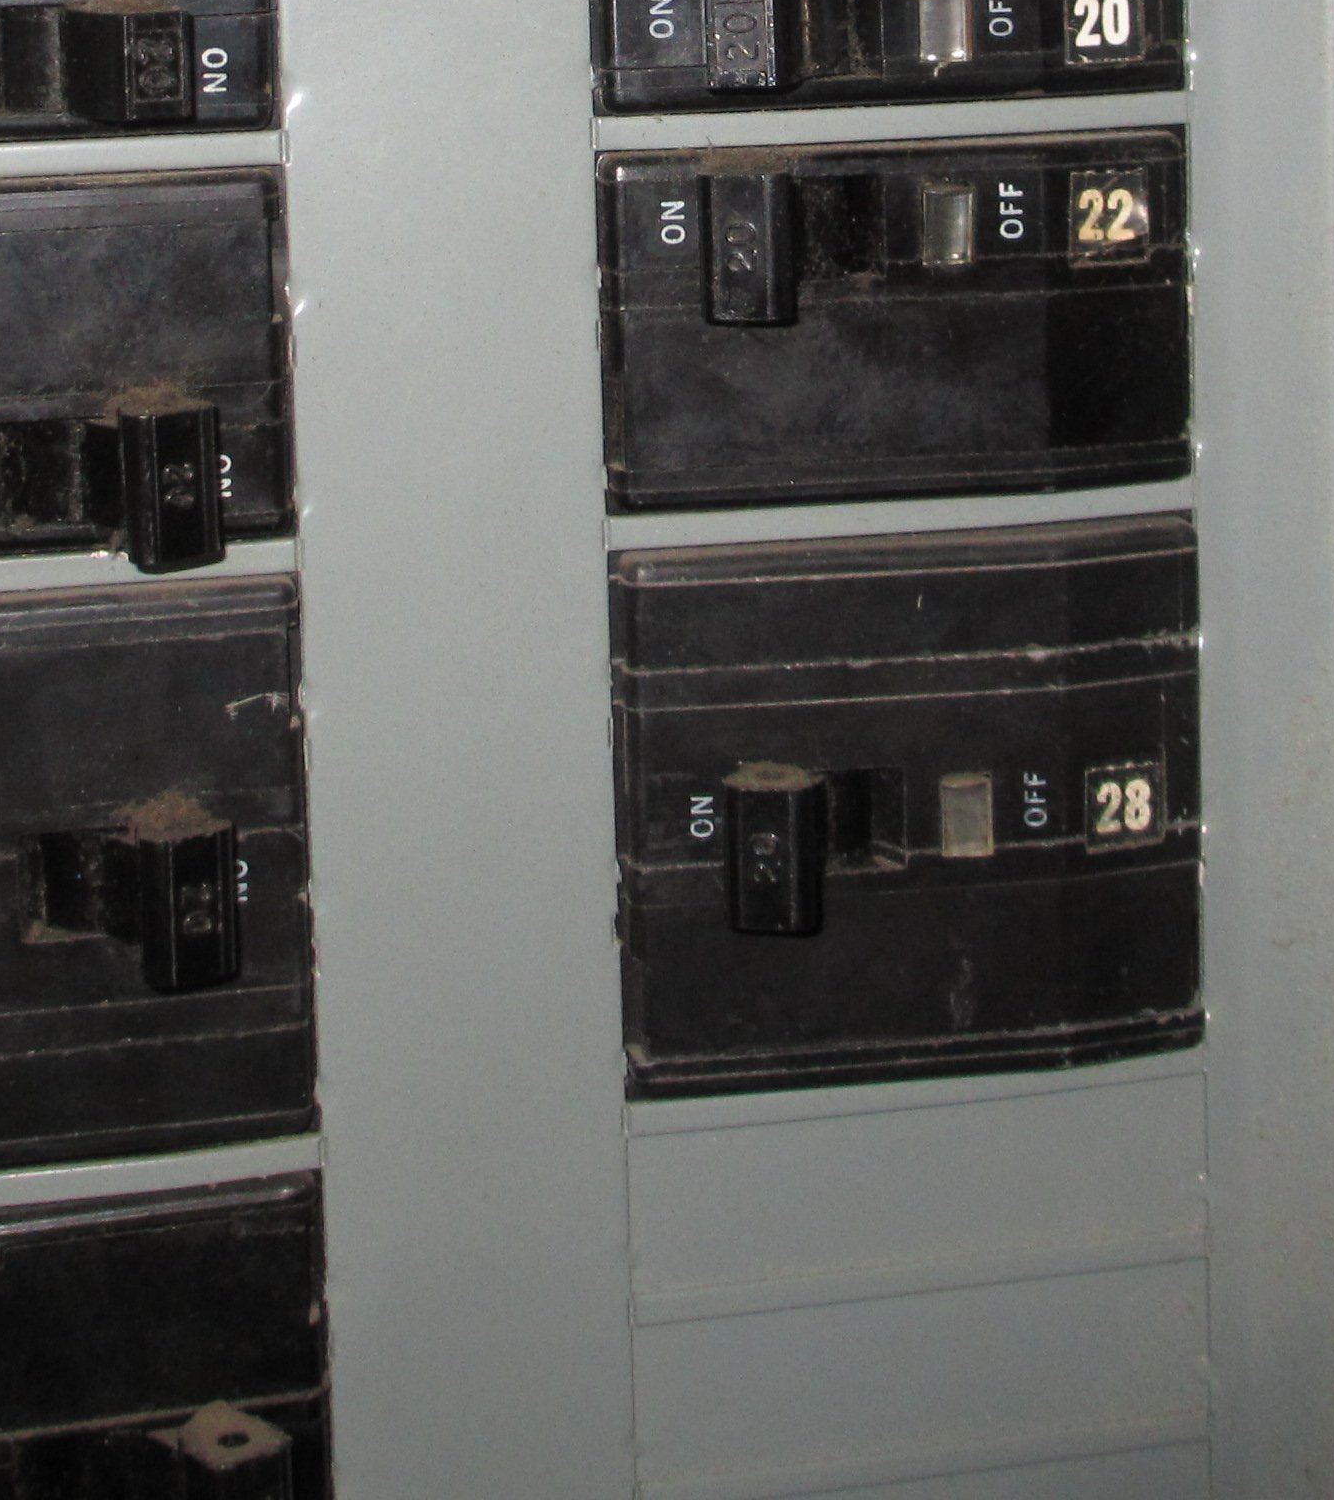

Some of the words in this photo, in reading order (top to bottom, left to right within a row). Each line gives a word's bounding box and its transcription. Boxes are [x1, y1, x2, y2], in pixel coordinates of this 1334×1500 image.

[723, 11, 761, 63] 20
[201, 47, 229, 94] ON
[660, 199, 687, 246] ON
[998, 181, 1026, 241] OFF
[1078, 188, 1136, 242] 22
[725, 221, 758, 274] 20
[689, 794, 716, 840] ON
[1022, 770, 1049, 829] OFF
[1094, 777, 1152, 833] 28
